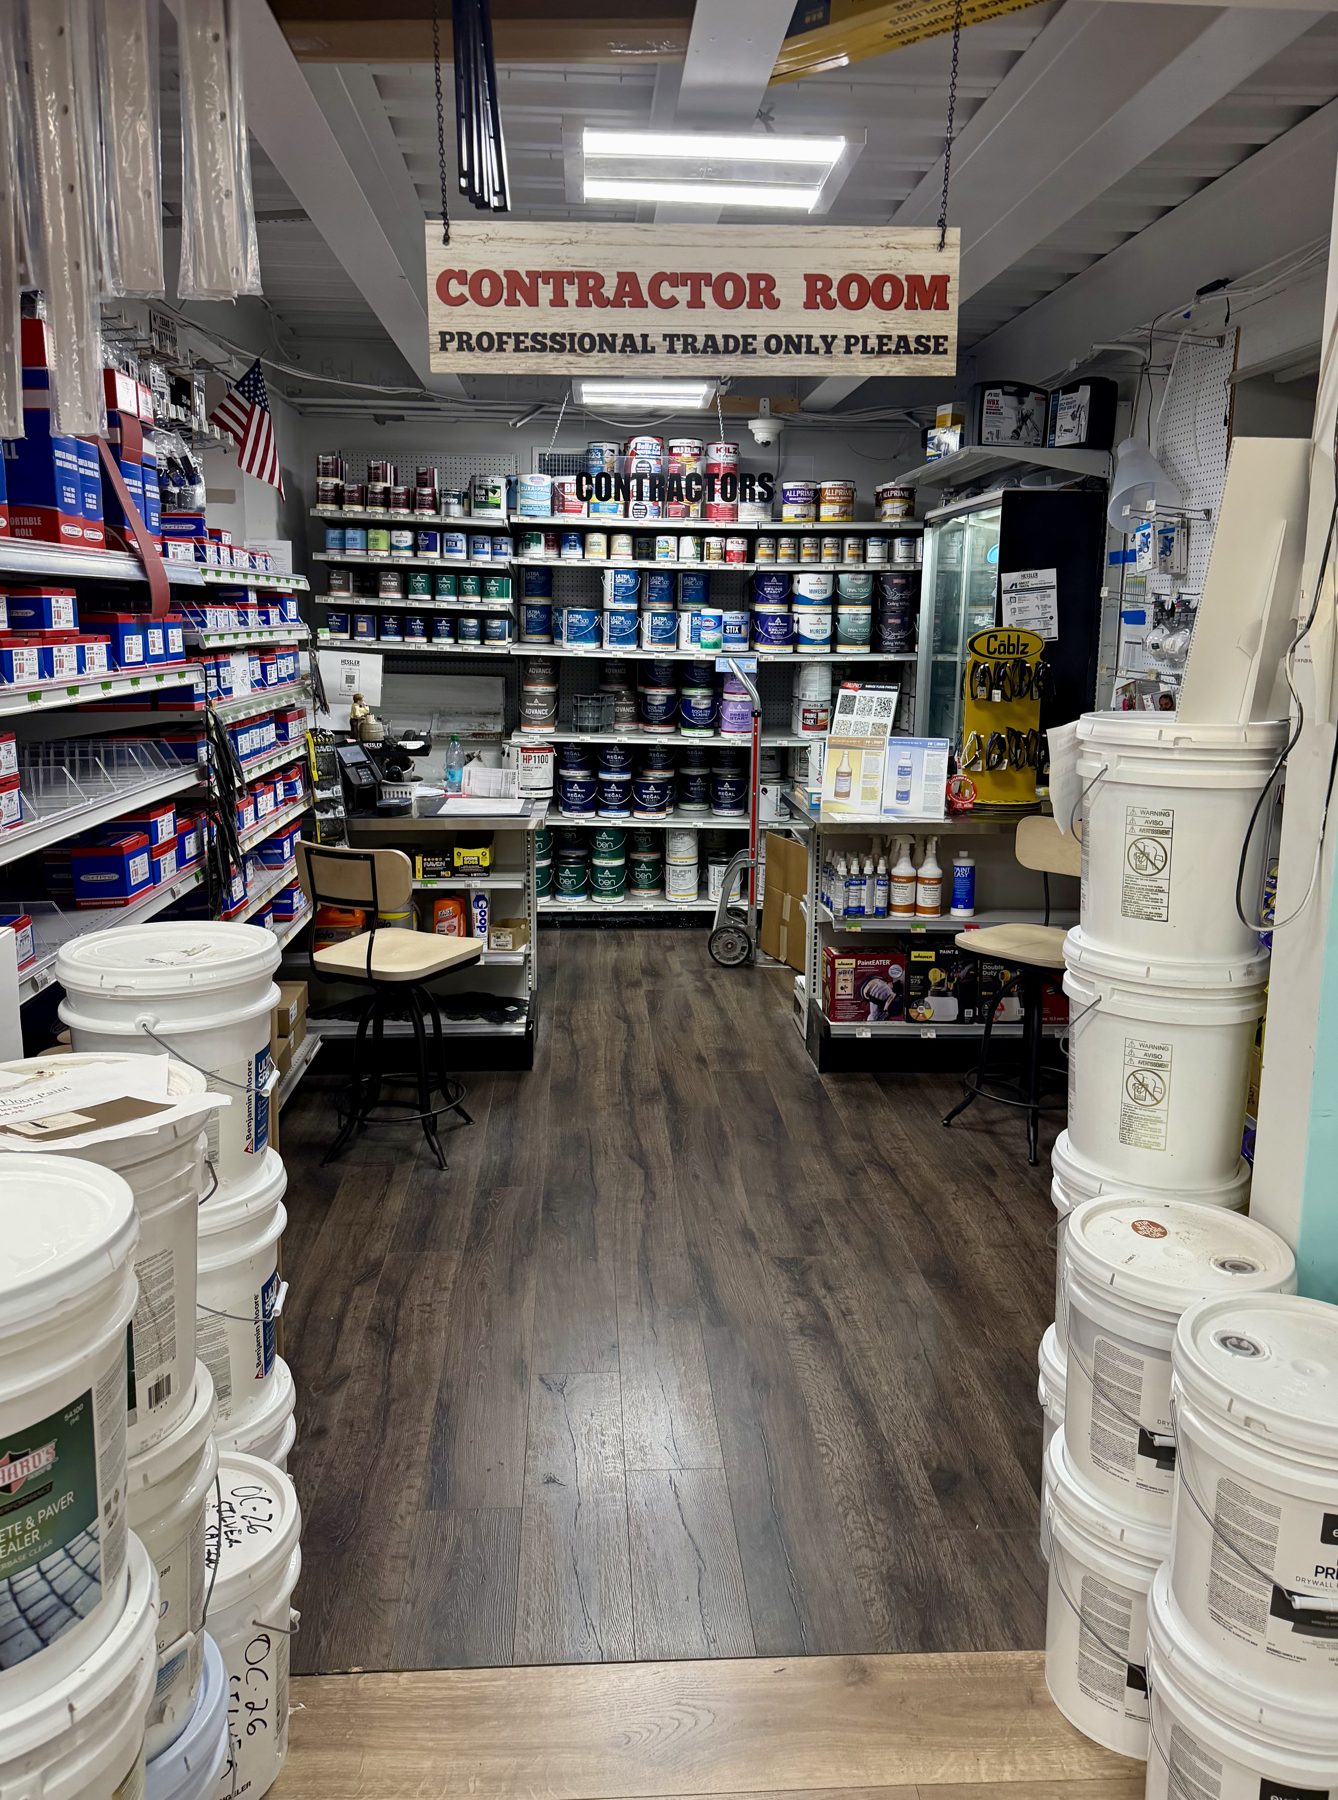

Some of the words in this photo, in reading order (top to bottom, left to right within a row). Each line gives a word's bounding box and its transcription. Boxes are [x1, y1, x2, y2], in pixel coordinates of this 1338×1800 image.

[435, 268, 781, 311] CONTRACTOR
[803, 273, 950, 311] ROOM
[438, 330, 657, 354] PROFESSIONAL
[662, 333, 757, 355] TRADE
[763, 334, 838, 355] ONLY
[843, 334, 949, 356] PLEASE
[575, 471, 775, 502] CONTRACTORS
[786, 489, 815, 498] ALLPRIME
[824, 489, 854, 498] ALLPRIME
[883, 489, 910, 498] ALLPRIME
[10, 516, 42, 526] ORTABLE
[725, 625, 739, 634] STIX
[1140, 809, 1170, 817] WARNING
[596, 839, 614, 848] ben
[635, 870, 652, 879] ben
[559, 876, 577, 885] ben
[597, 877, 616, 886] ben
[476, 900, 489, 933] Goop
[1139, 1042, 1169, 1051] WARNING
[37, 1086, 71, 1098] Paint
[245, 1094, 253, 1141] Benjamin
[254, 1325, 262, 1368] Benjamin
[26, 1516, 35, 1529] &
[38, 1491, 74, 1524] PAVER
[28, 1539, 54, 1557] CLEAR
[1295, 1576, 1333, 1589] DRYWALL
